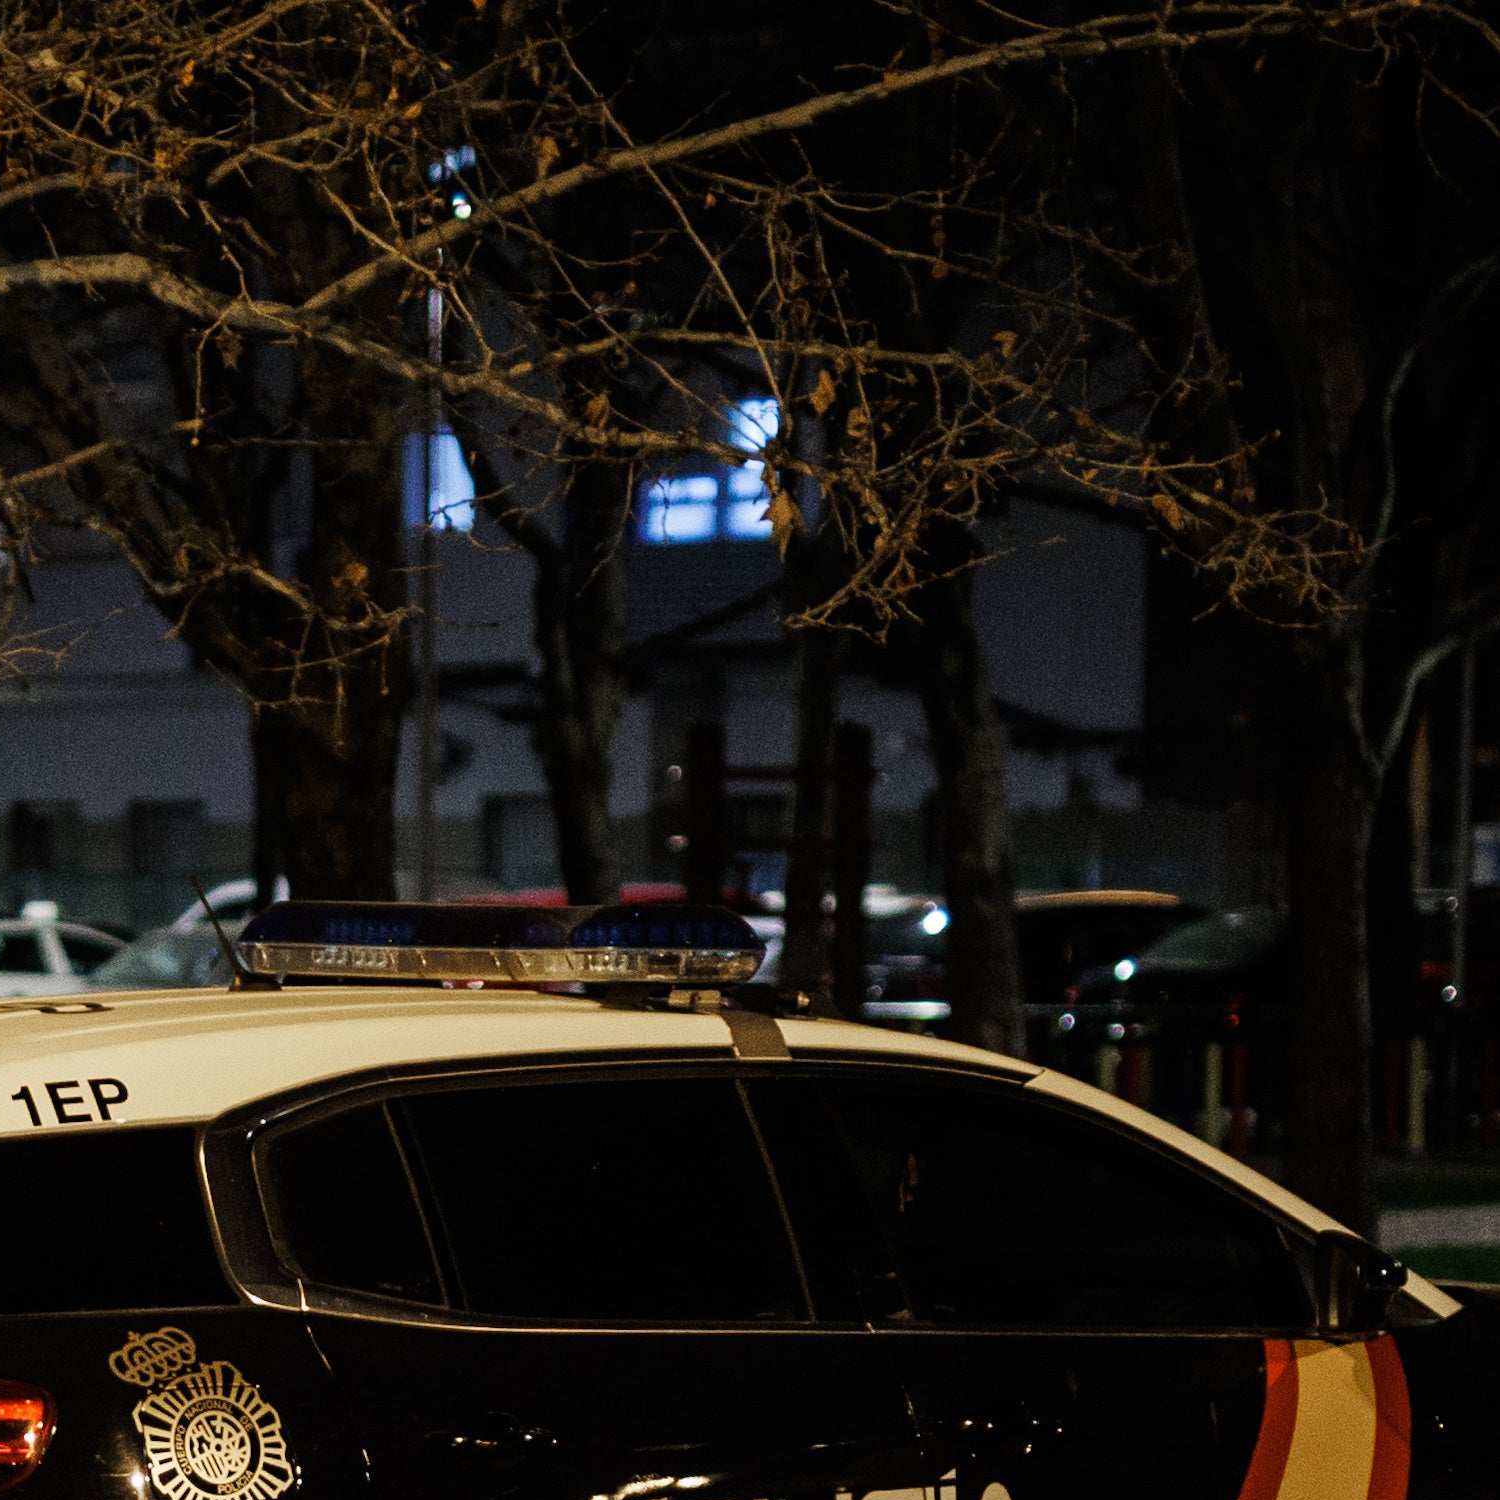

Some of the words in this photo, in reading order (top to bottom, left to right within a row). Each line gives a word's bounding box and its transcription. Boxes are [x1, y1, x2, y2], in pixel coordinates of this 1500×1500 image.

[11, 1077, 129, 1127] 1EP
[175, 1425, 192, 1475] CUERPO
[184, 1400, 232, 1420] NACIONAL
[240, 1415, 254, 1432] DE
